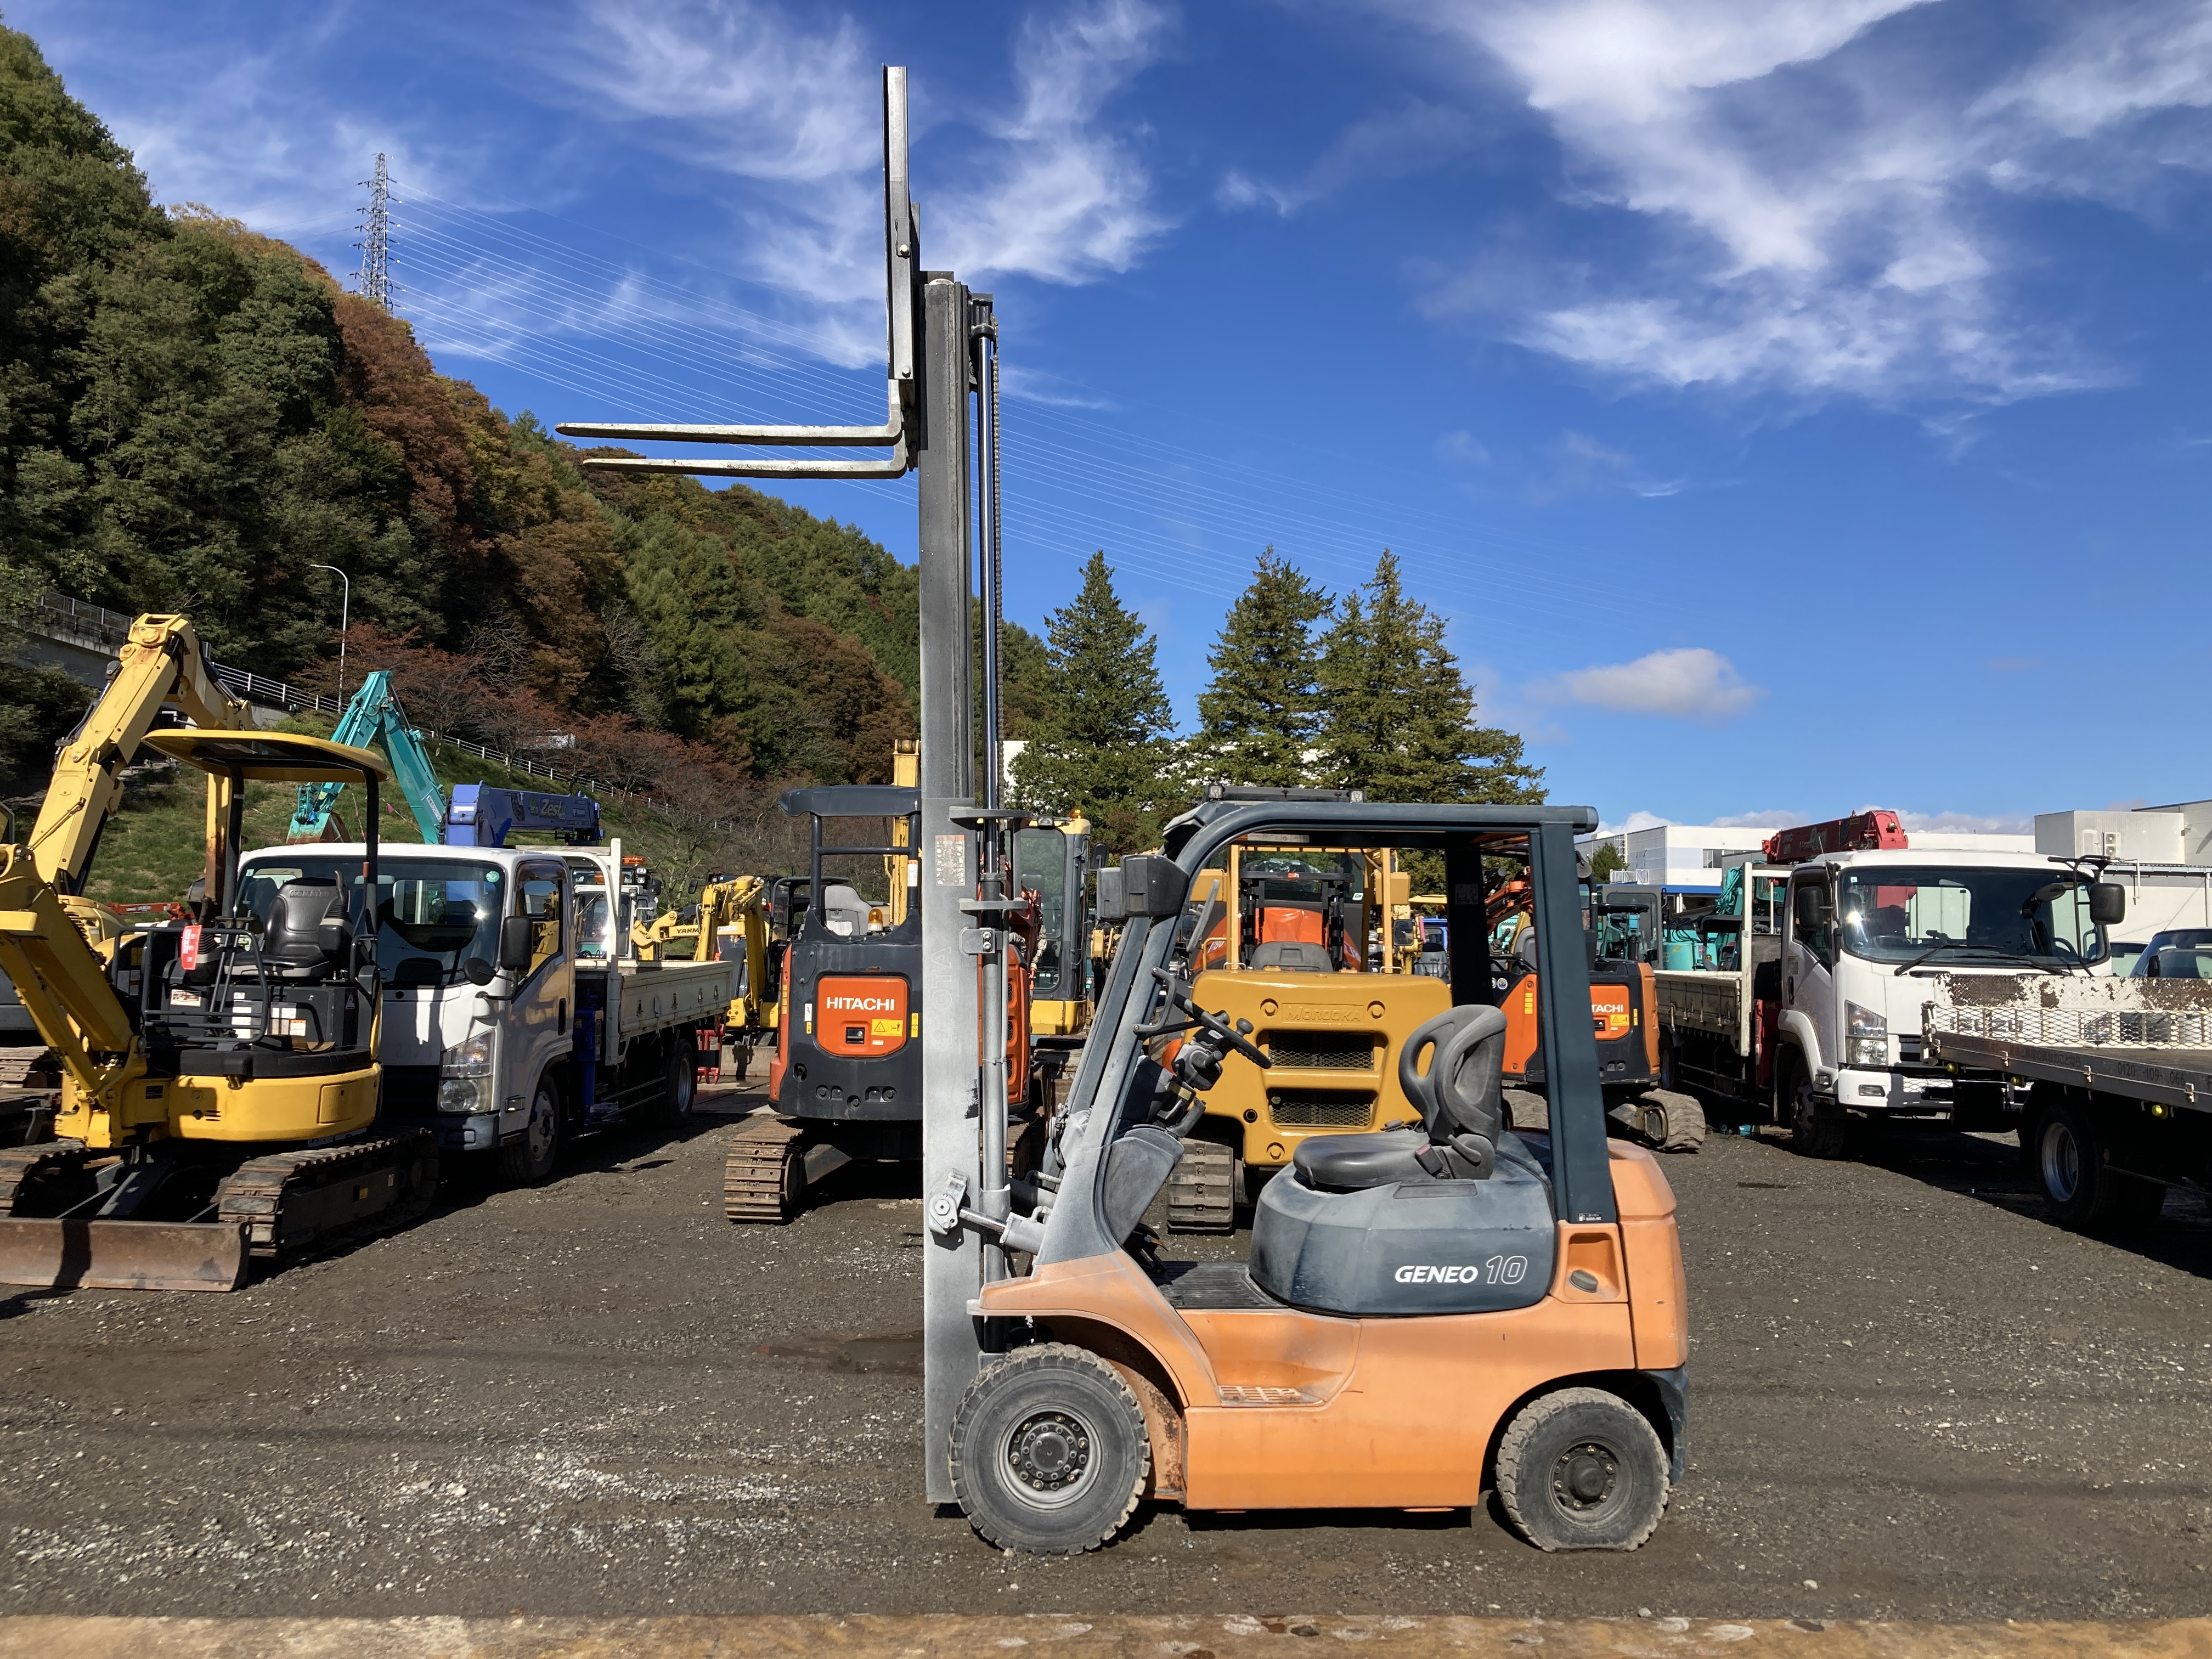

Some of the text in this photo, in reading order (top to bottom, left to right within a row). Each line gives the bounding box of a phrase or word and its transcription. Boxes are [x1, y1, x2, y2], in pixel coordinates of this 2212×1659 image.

[826, 997, 895, 1011] HITACHI
[1592, 1004, 1623, 1013] TACHI
[1285, 1006, 1361, 1021] MOROOKA
[1950, 1018, 2023, 1032] ISUZU
[1395, 1255, 1528, 1284] GENEO 10
